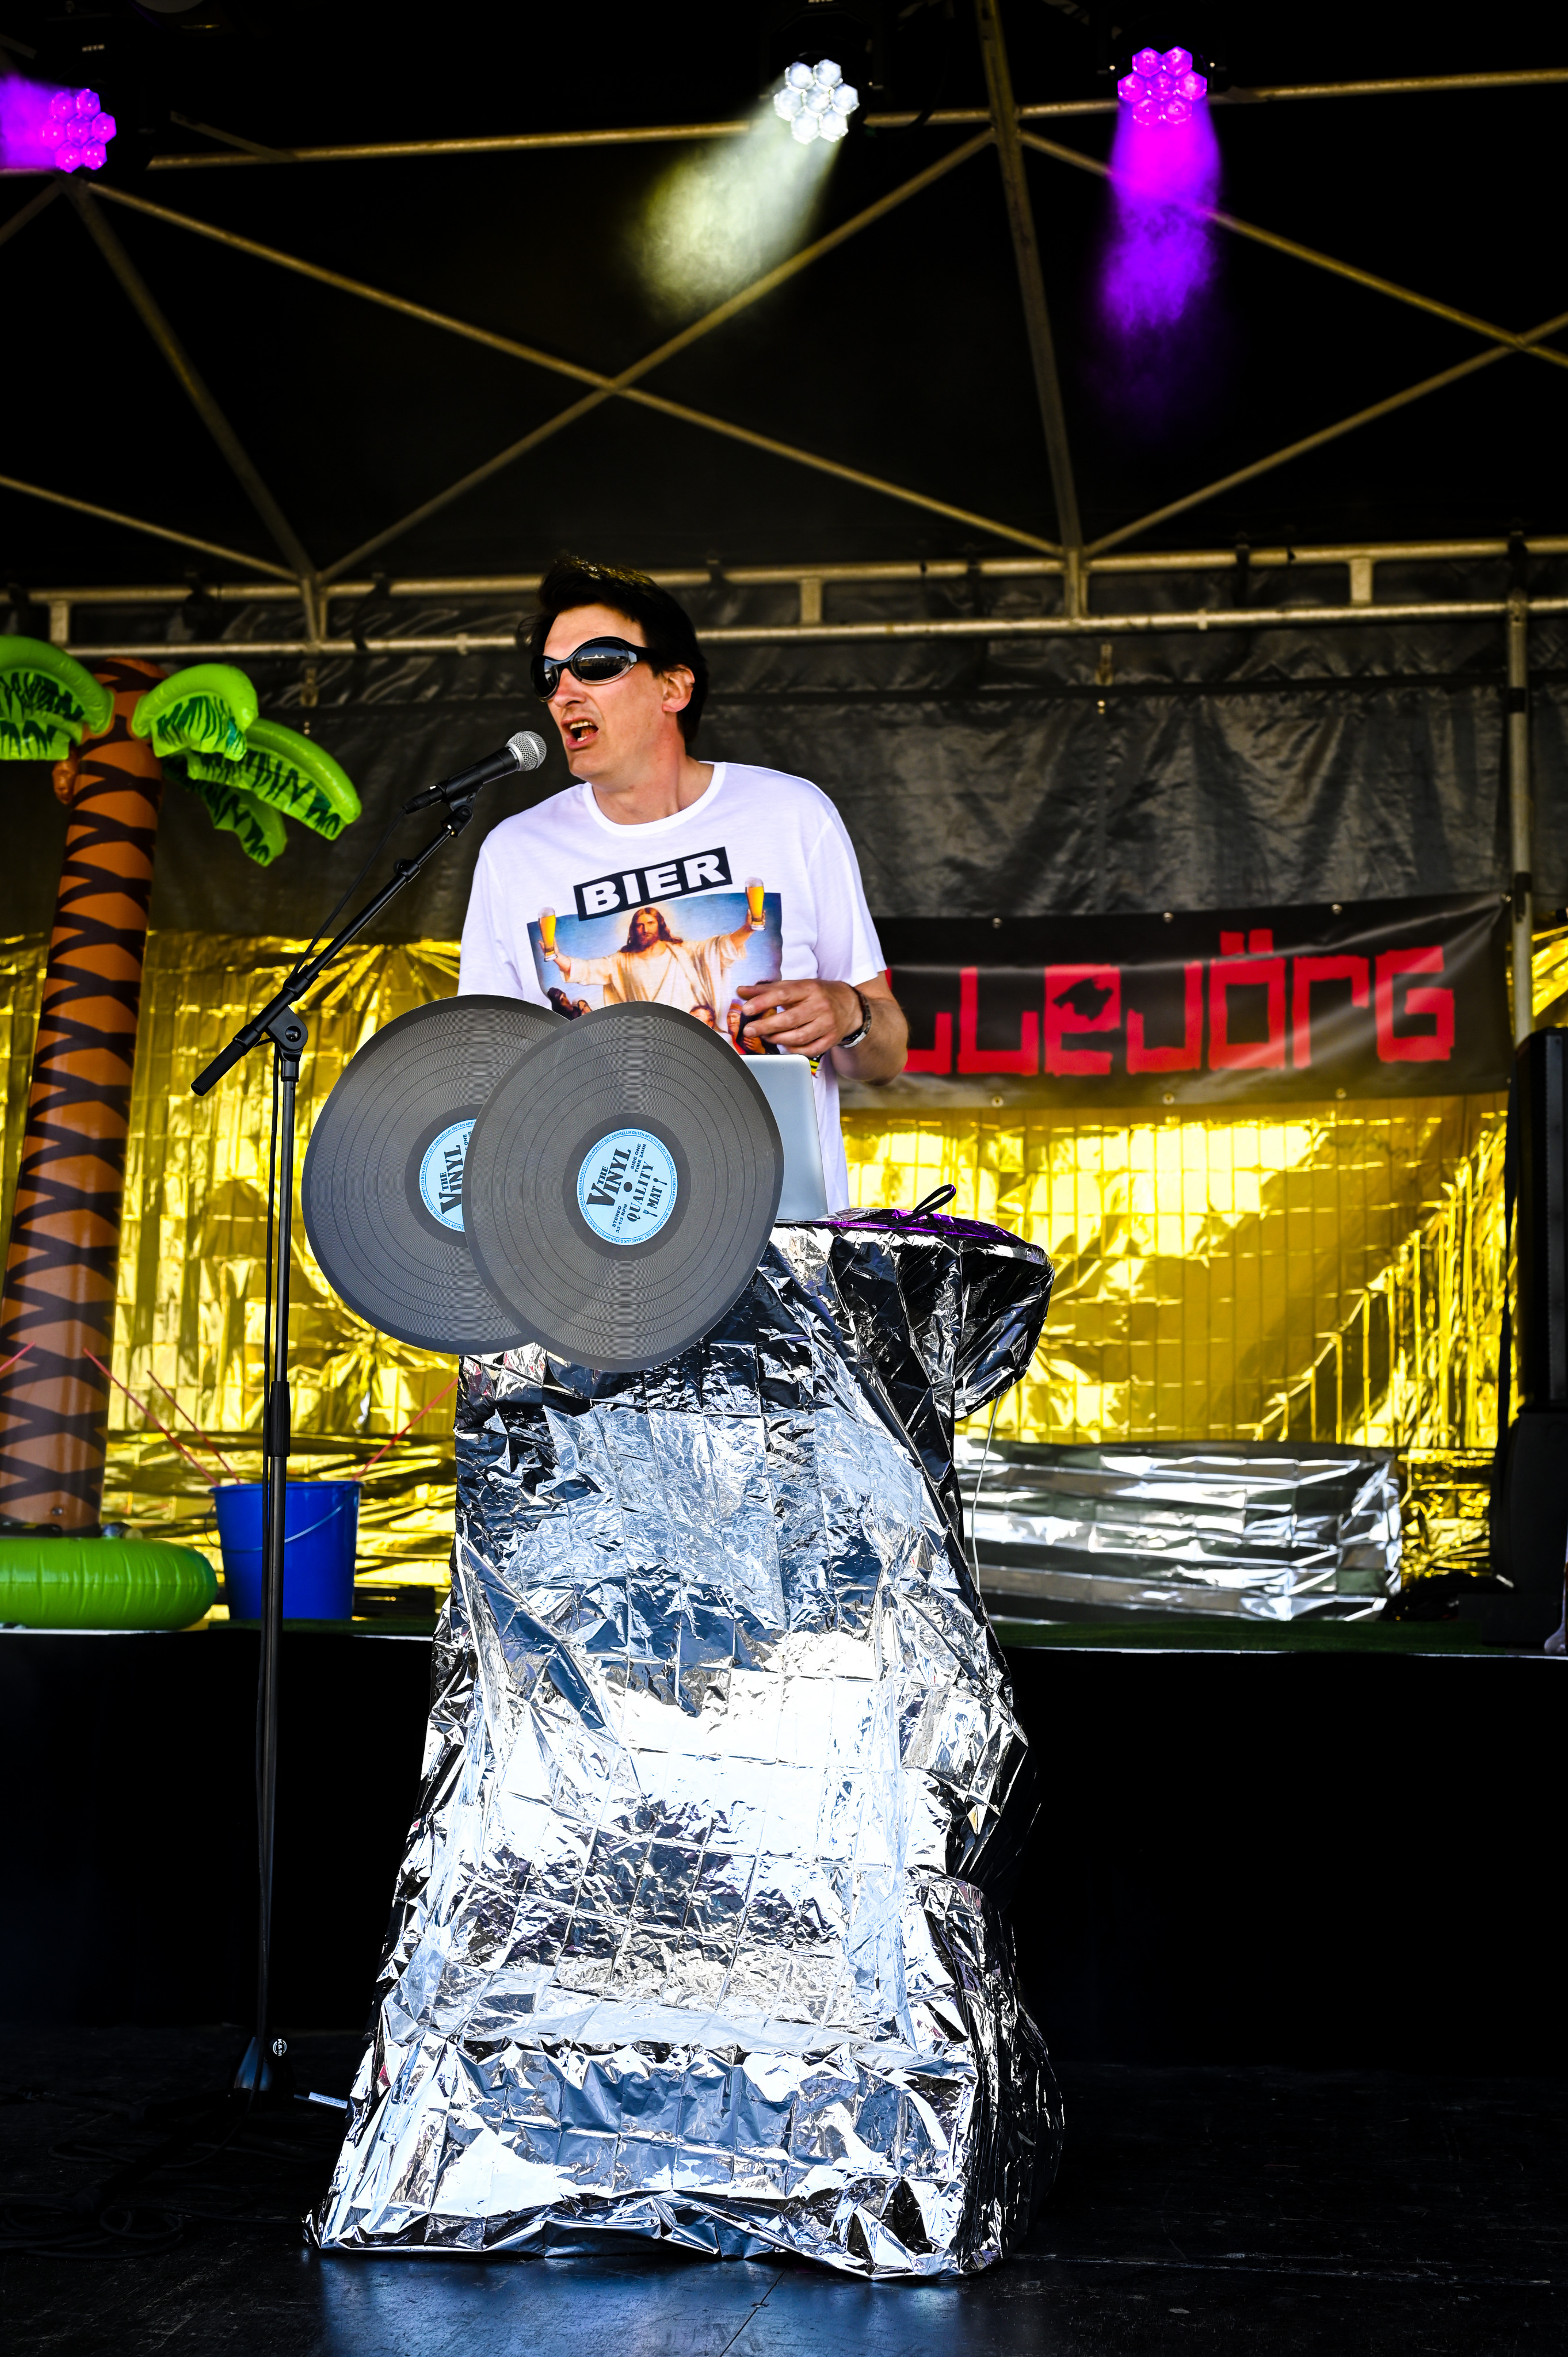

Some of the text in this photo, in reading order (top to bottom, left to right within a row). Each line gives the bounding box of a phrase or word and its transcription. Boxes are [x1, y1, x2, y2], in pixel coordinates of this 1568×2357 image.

[582, 854, 726, 916] BIER
[592, 1141, 604, 1154] APPETIT
[644, 1134, 659, 1144] APPETIT
[658, 1143, 667, 1154] ENJOY
[422, 1153, 430, 1170] APPETIT
[438, 1145, 463, 1214] VINYL
[440, 1172, 449, 1191] THE
[579, 1162, 587, 1183] APPETITO
[586, 1148, 632, 1206] VINYL
[597, 1166, 608, 1185] THE
[627, 1161, 654, 1222] QUALITY
[647, 1186, 662, 1209] MAT
[433, 1210, 441, 1219] MEAL
[440, 1218, 450, 1226] YOUR
[612, 1206, 622, 1227] STEREO
[587, 1219, 598, 1230] ENJOY
[651, 1221, 663, 1234] APPETIT
[597, 1229, 610, 1239] APPETIT
